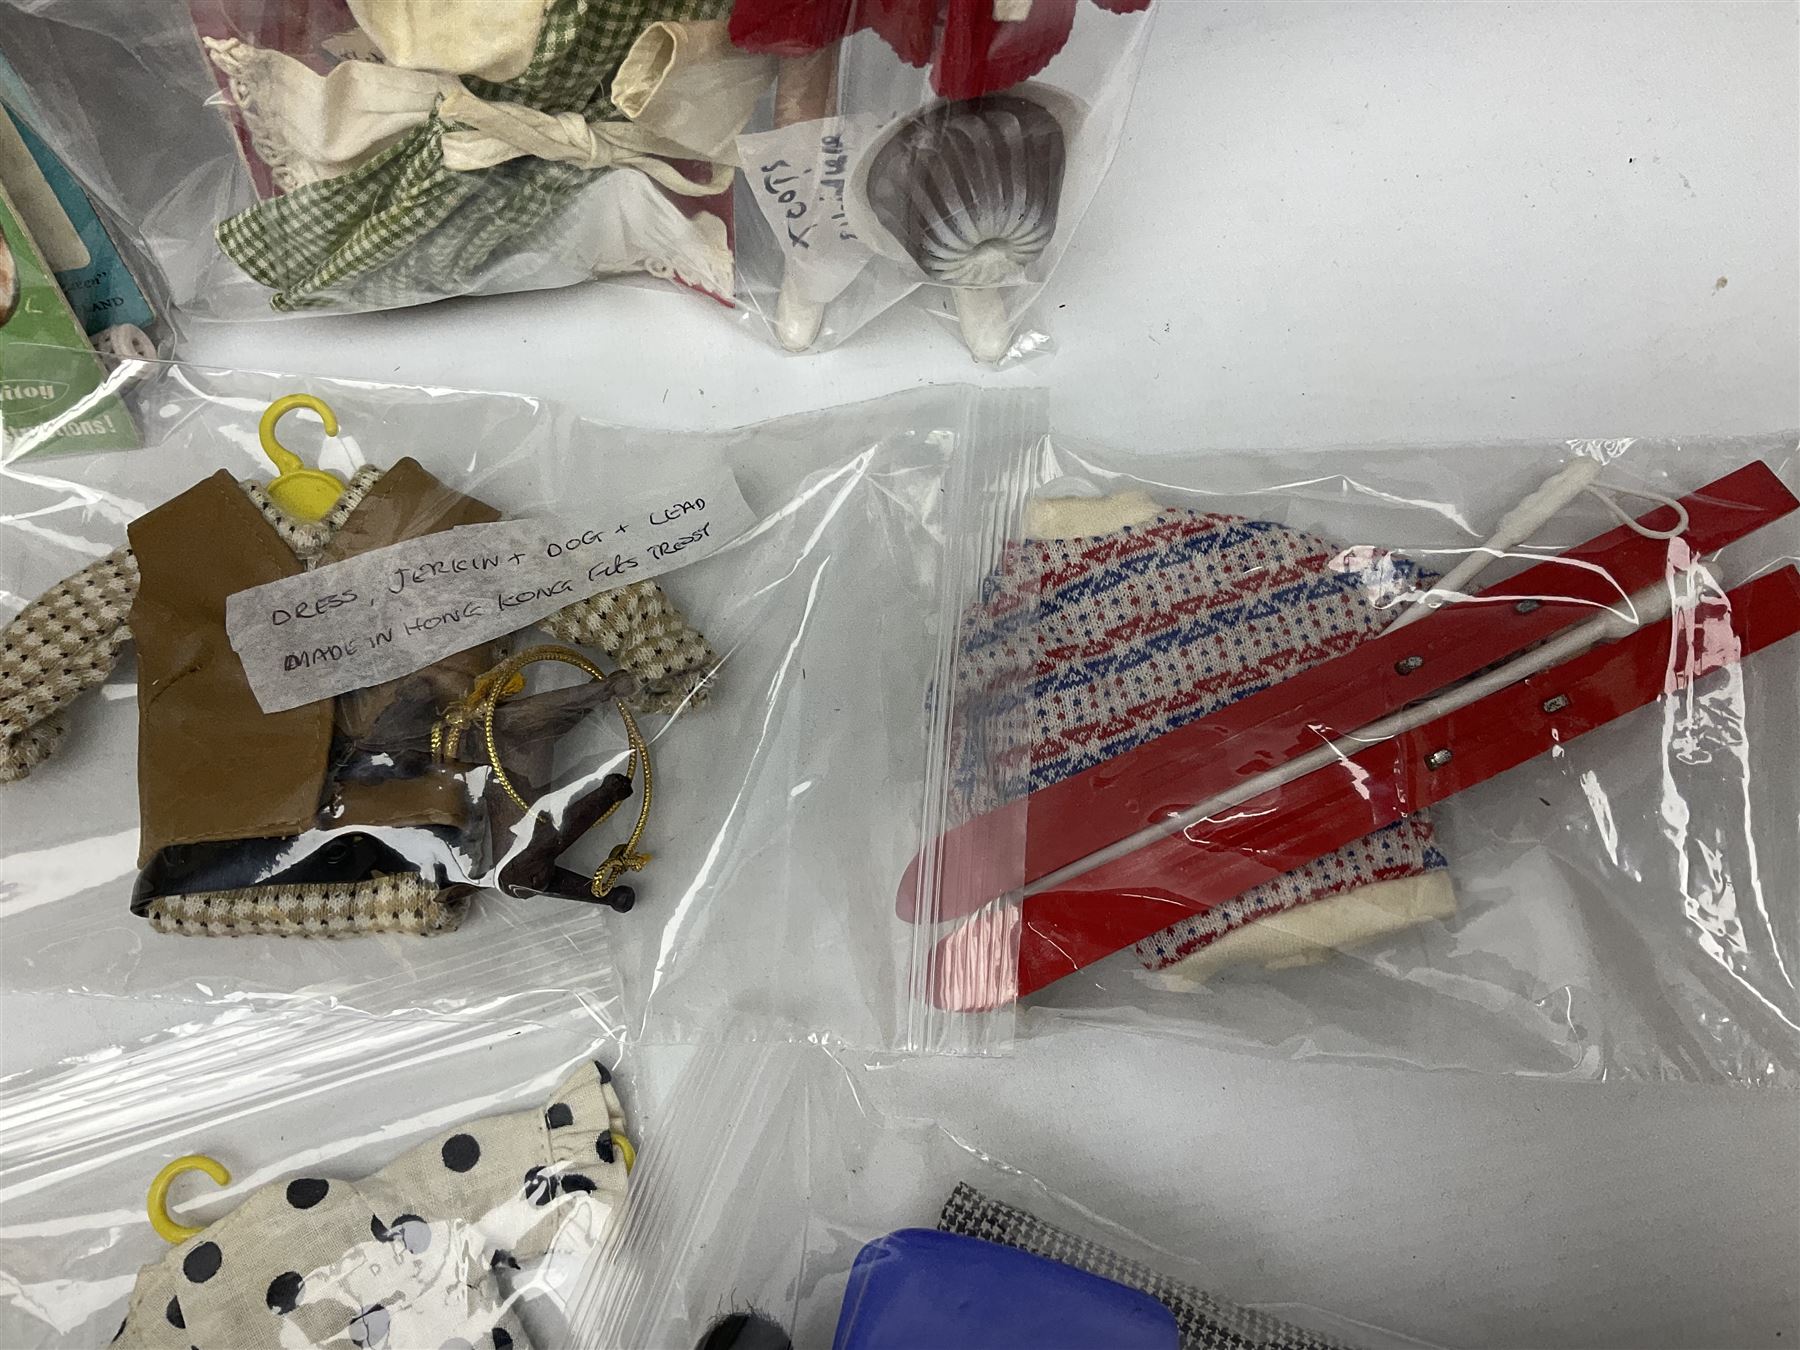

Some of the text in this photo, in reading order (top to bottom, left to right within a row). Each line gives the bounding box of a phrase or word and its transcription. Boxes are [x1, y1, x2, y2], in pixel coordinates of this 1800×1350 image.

[92, 297, 124, 312] AND
[388, 555, 499, 594] JERKIN
[547, 530, 605, 558] DOG
[649, 497, 706, 525] LEAD
[368, 627, 393, 649] IN
[403, 601, 484, 636] HONG
[498, 580, 573, 611] KONG
